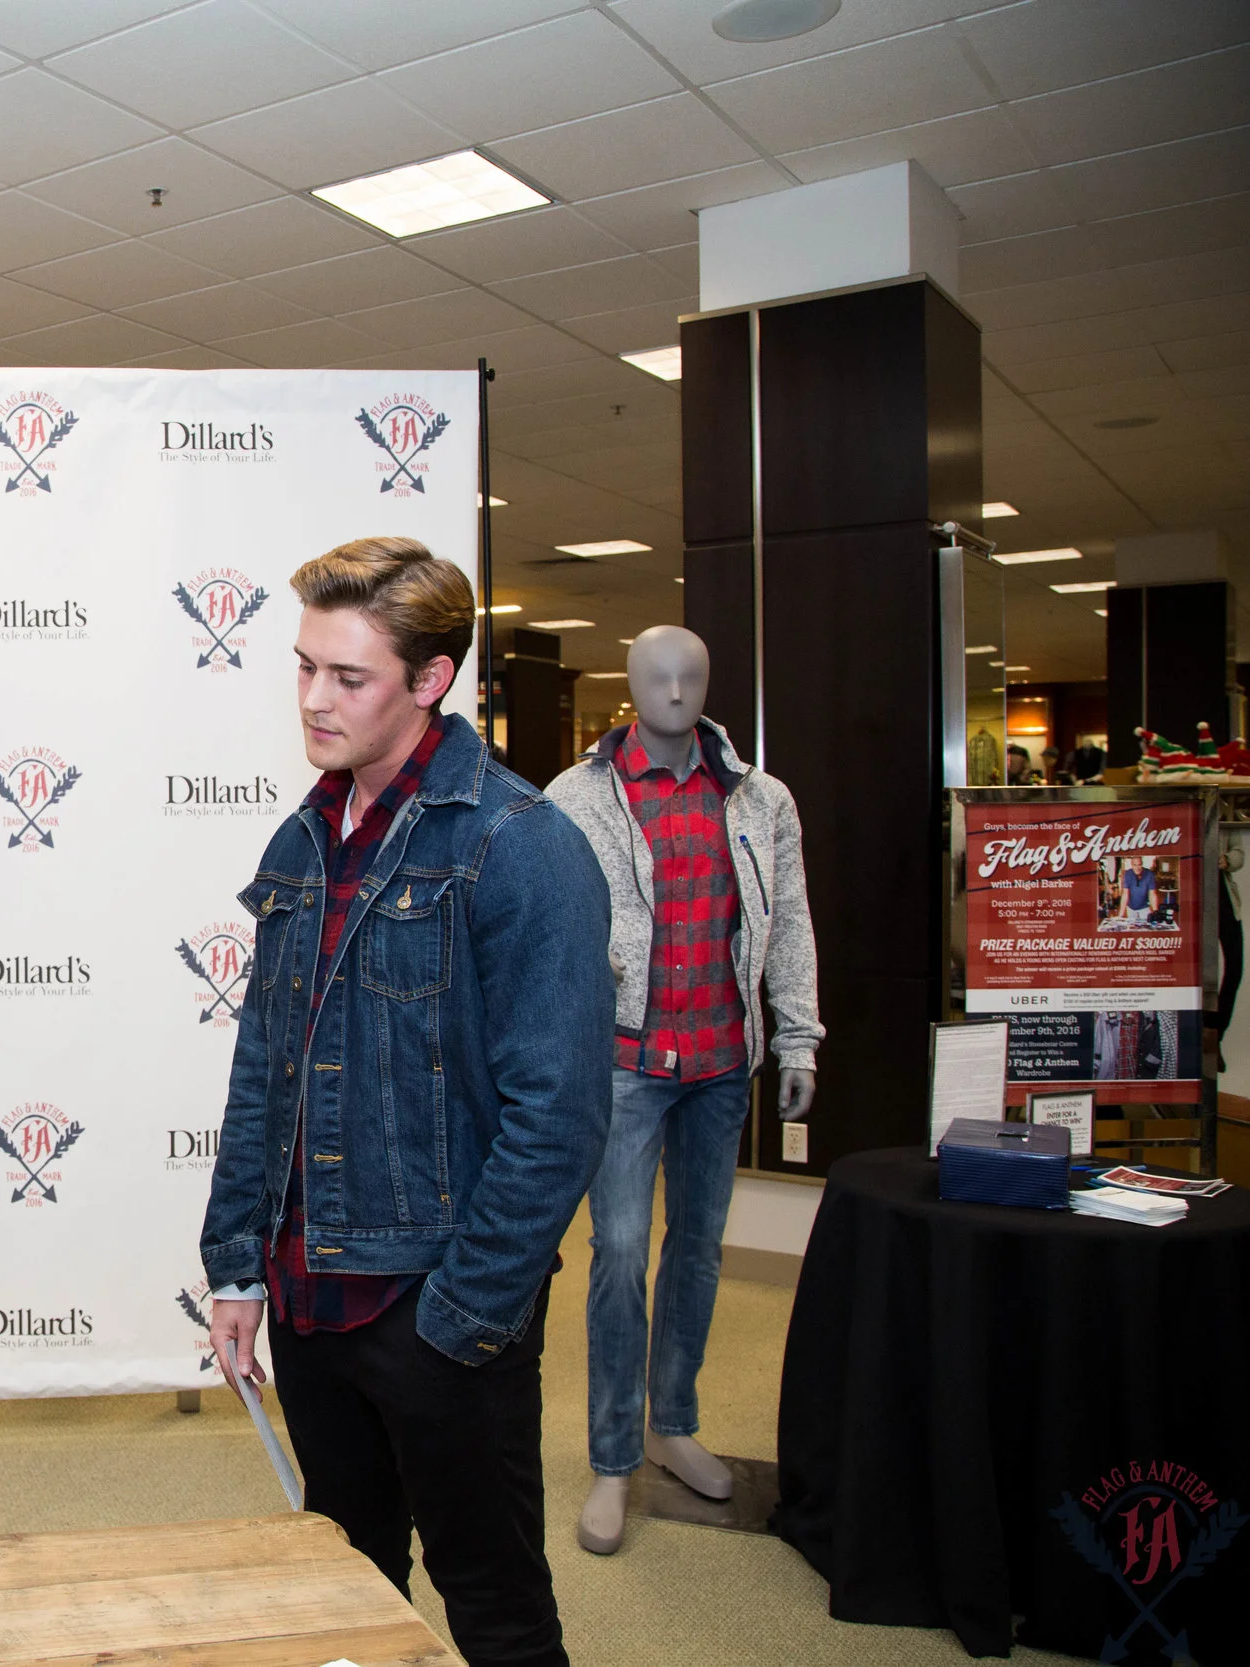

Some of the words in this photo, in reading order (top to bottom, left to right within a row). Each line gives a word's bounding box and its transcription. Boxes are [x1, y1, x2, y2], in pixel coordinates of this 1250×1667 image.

[371, 397, 393, 418] FLAG
[403, 394, 436, 418] ANTHEM
[160, 422, 274, 450] Dillard's
[158, 452, 178, 462] The
[180, 452, 207, 464] Style
[209, 452, 221, 462] of
[224, 452, 249, 462] Your
[375, 462, 395, 472] TRADE
[410, 462, 430, 472] MARK
[393, 488, 411, 498] 2016
[188, 570, 210, 592] FLAG
[220, 567, 254, 592] ANTHEM
[22, 628, 35, 638] of
[38, 628, 63, 638] Your
[165, 776, 278, 804] Dillard's
[163, 806, 183, 816] The
[185, 806, 212, 818] Style
[214, 806, 225, 816] of
[228, 806, 253, 816] Your
[984, 823, 1006, 832] Guys,
[1040, 822, 1053, 830] the
[1054, 822, 1071, 830] face
[1072, 821, 1081, 829] of
[978, 836, 1050, 878] Flag
[1049, 832, 1074, 873] &
[1070, 817, 1182, 864] Anthem
[991, 879, 1013, 889] with
[1014, 879, 1039, 890] Nigel
[1041, 879, 1074, 889] Barker
[991, 899, 1035, 907] December
[1052, 899, 1072, 907] 2016
[998, 909, 1017, 917] 5:00
[1035, 909, 1054, 917] 7:00
[980, 938, 1014, 951] PRIZE
[1016, 938, 1070, 951] PACKAGE
[1073, 937, 1117, 950] VALUED
[1118, 937, 1135, 949] AT
[1135, 936, 1182, 950] $3000!!!
[230, 992, 246, 1001] MAR
[1011, 996, 1048, 1004] UBER
[1021, 1016, 1041, 1024] now
[1042, 1014, 1078, 1025] through
[1010, 1026, 1037, 1035] mber
[1037, 1026, 1055, 1036] 9th,
[1056, 1026, 1081, 1035] 2016
[1013, 1059, 1033, 1068] Flag
[1035, 1058, 1043, 1067] &
[1044, 1058, 1079, 1067] Anthem
[2, 1106, 25, 1127] FLAG
[35, 1103, 70, 1127] ANTHEM
